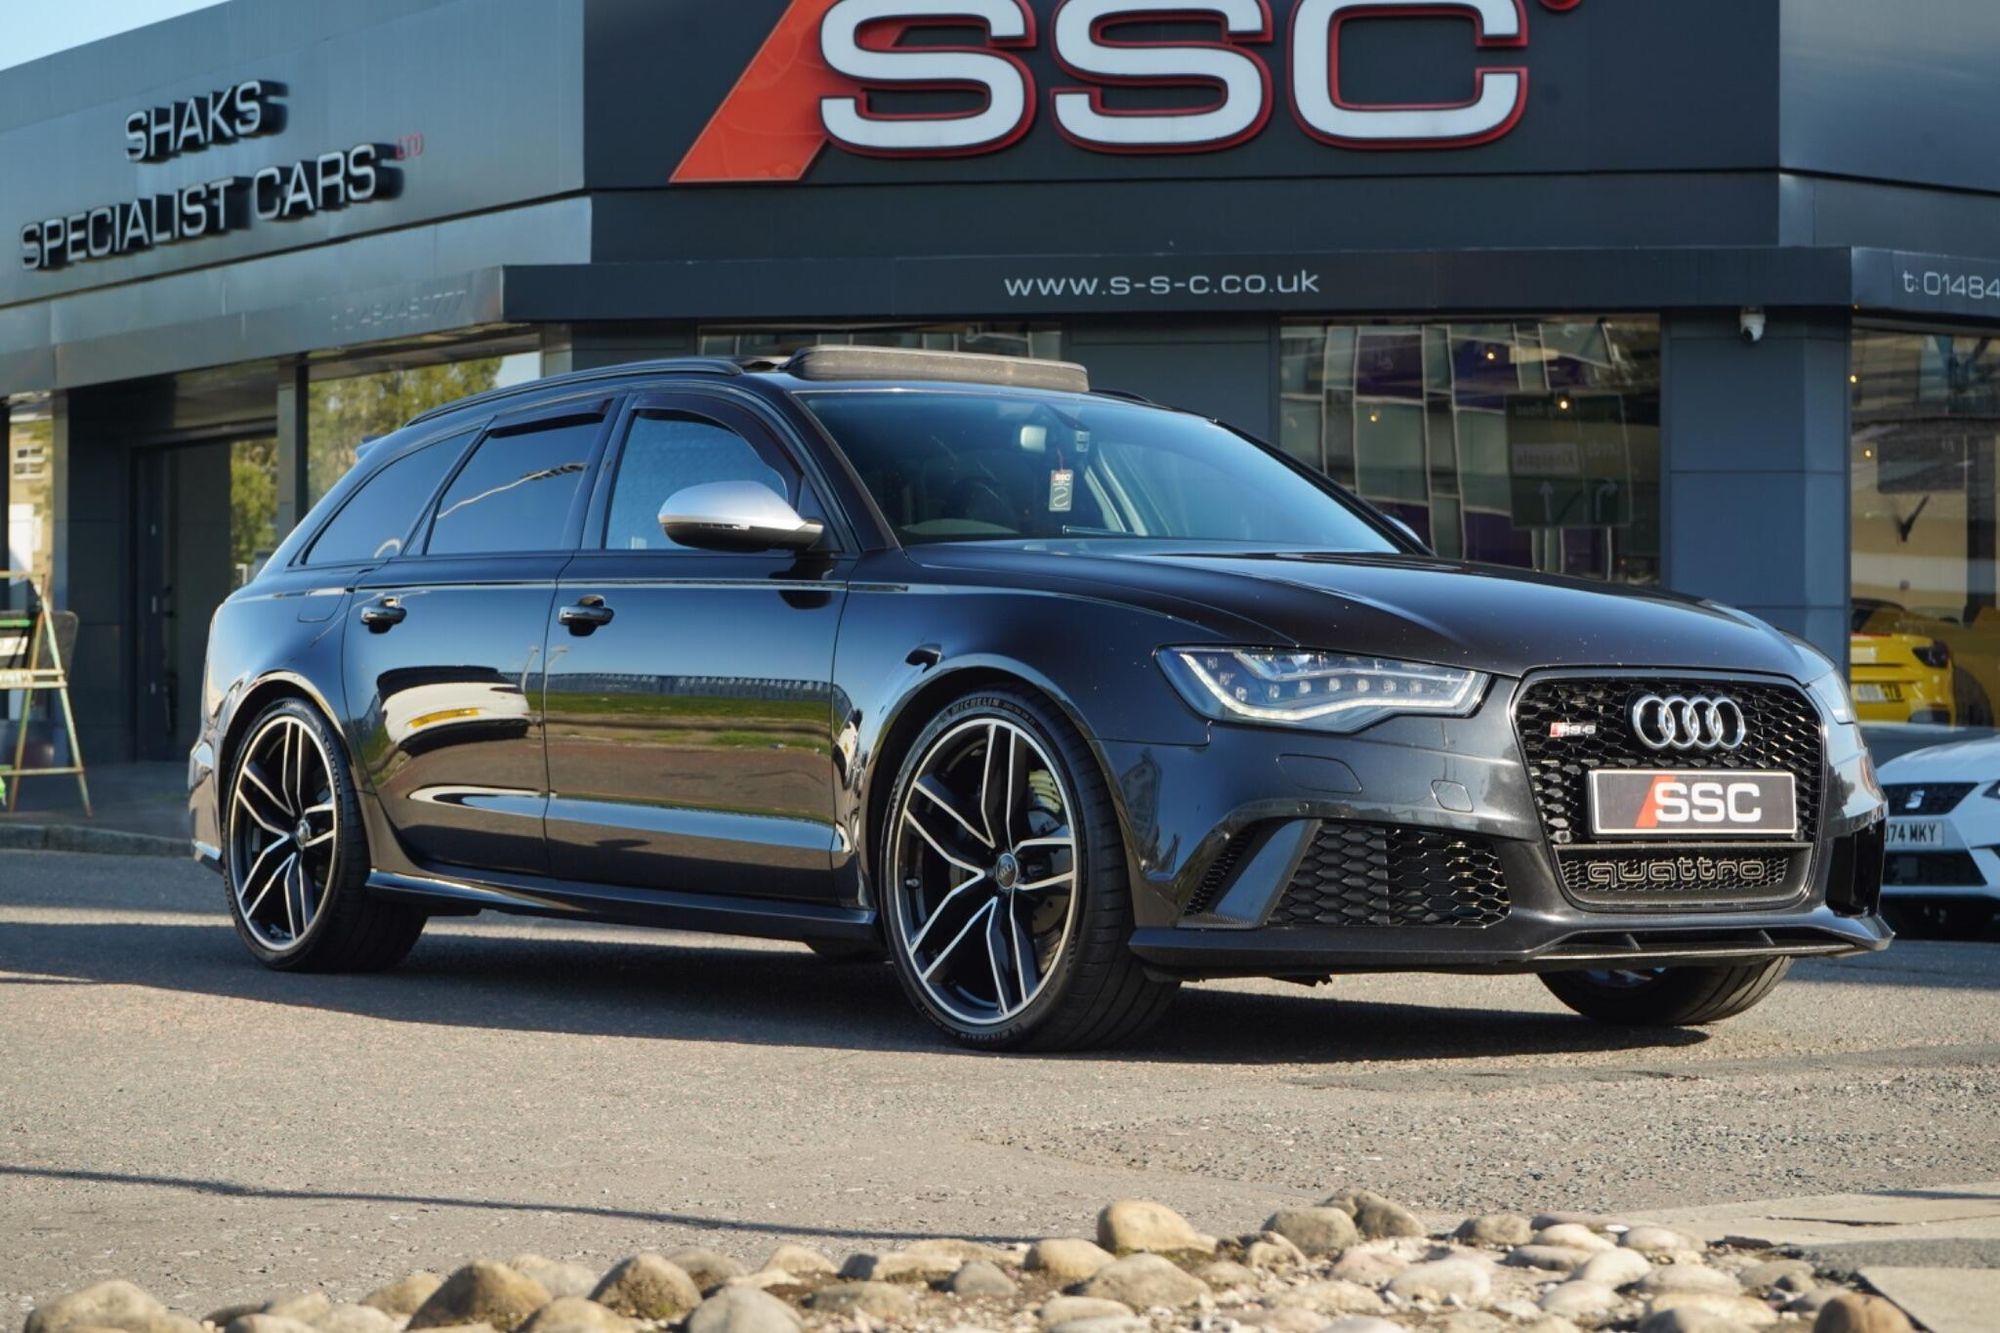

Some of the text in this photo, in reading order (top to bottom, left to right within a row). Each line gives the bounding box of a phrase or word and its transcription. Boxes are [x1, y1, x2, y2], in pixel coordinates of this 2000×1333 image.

[818, 0, 1526, 152] SSC
[125, 79, 264, 161] SHAKS
[21, 177, 236, 270] SPECIALIST
[253, 143, 379, 221] CARS
[1003, 270, 1320, 296] www.s-s-c.co.uk
[1653, 781, 1763, 823] SSC
[1909, 823, 1937, 843] MKY
[1587, 856, 1765, 888] quattro
